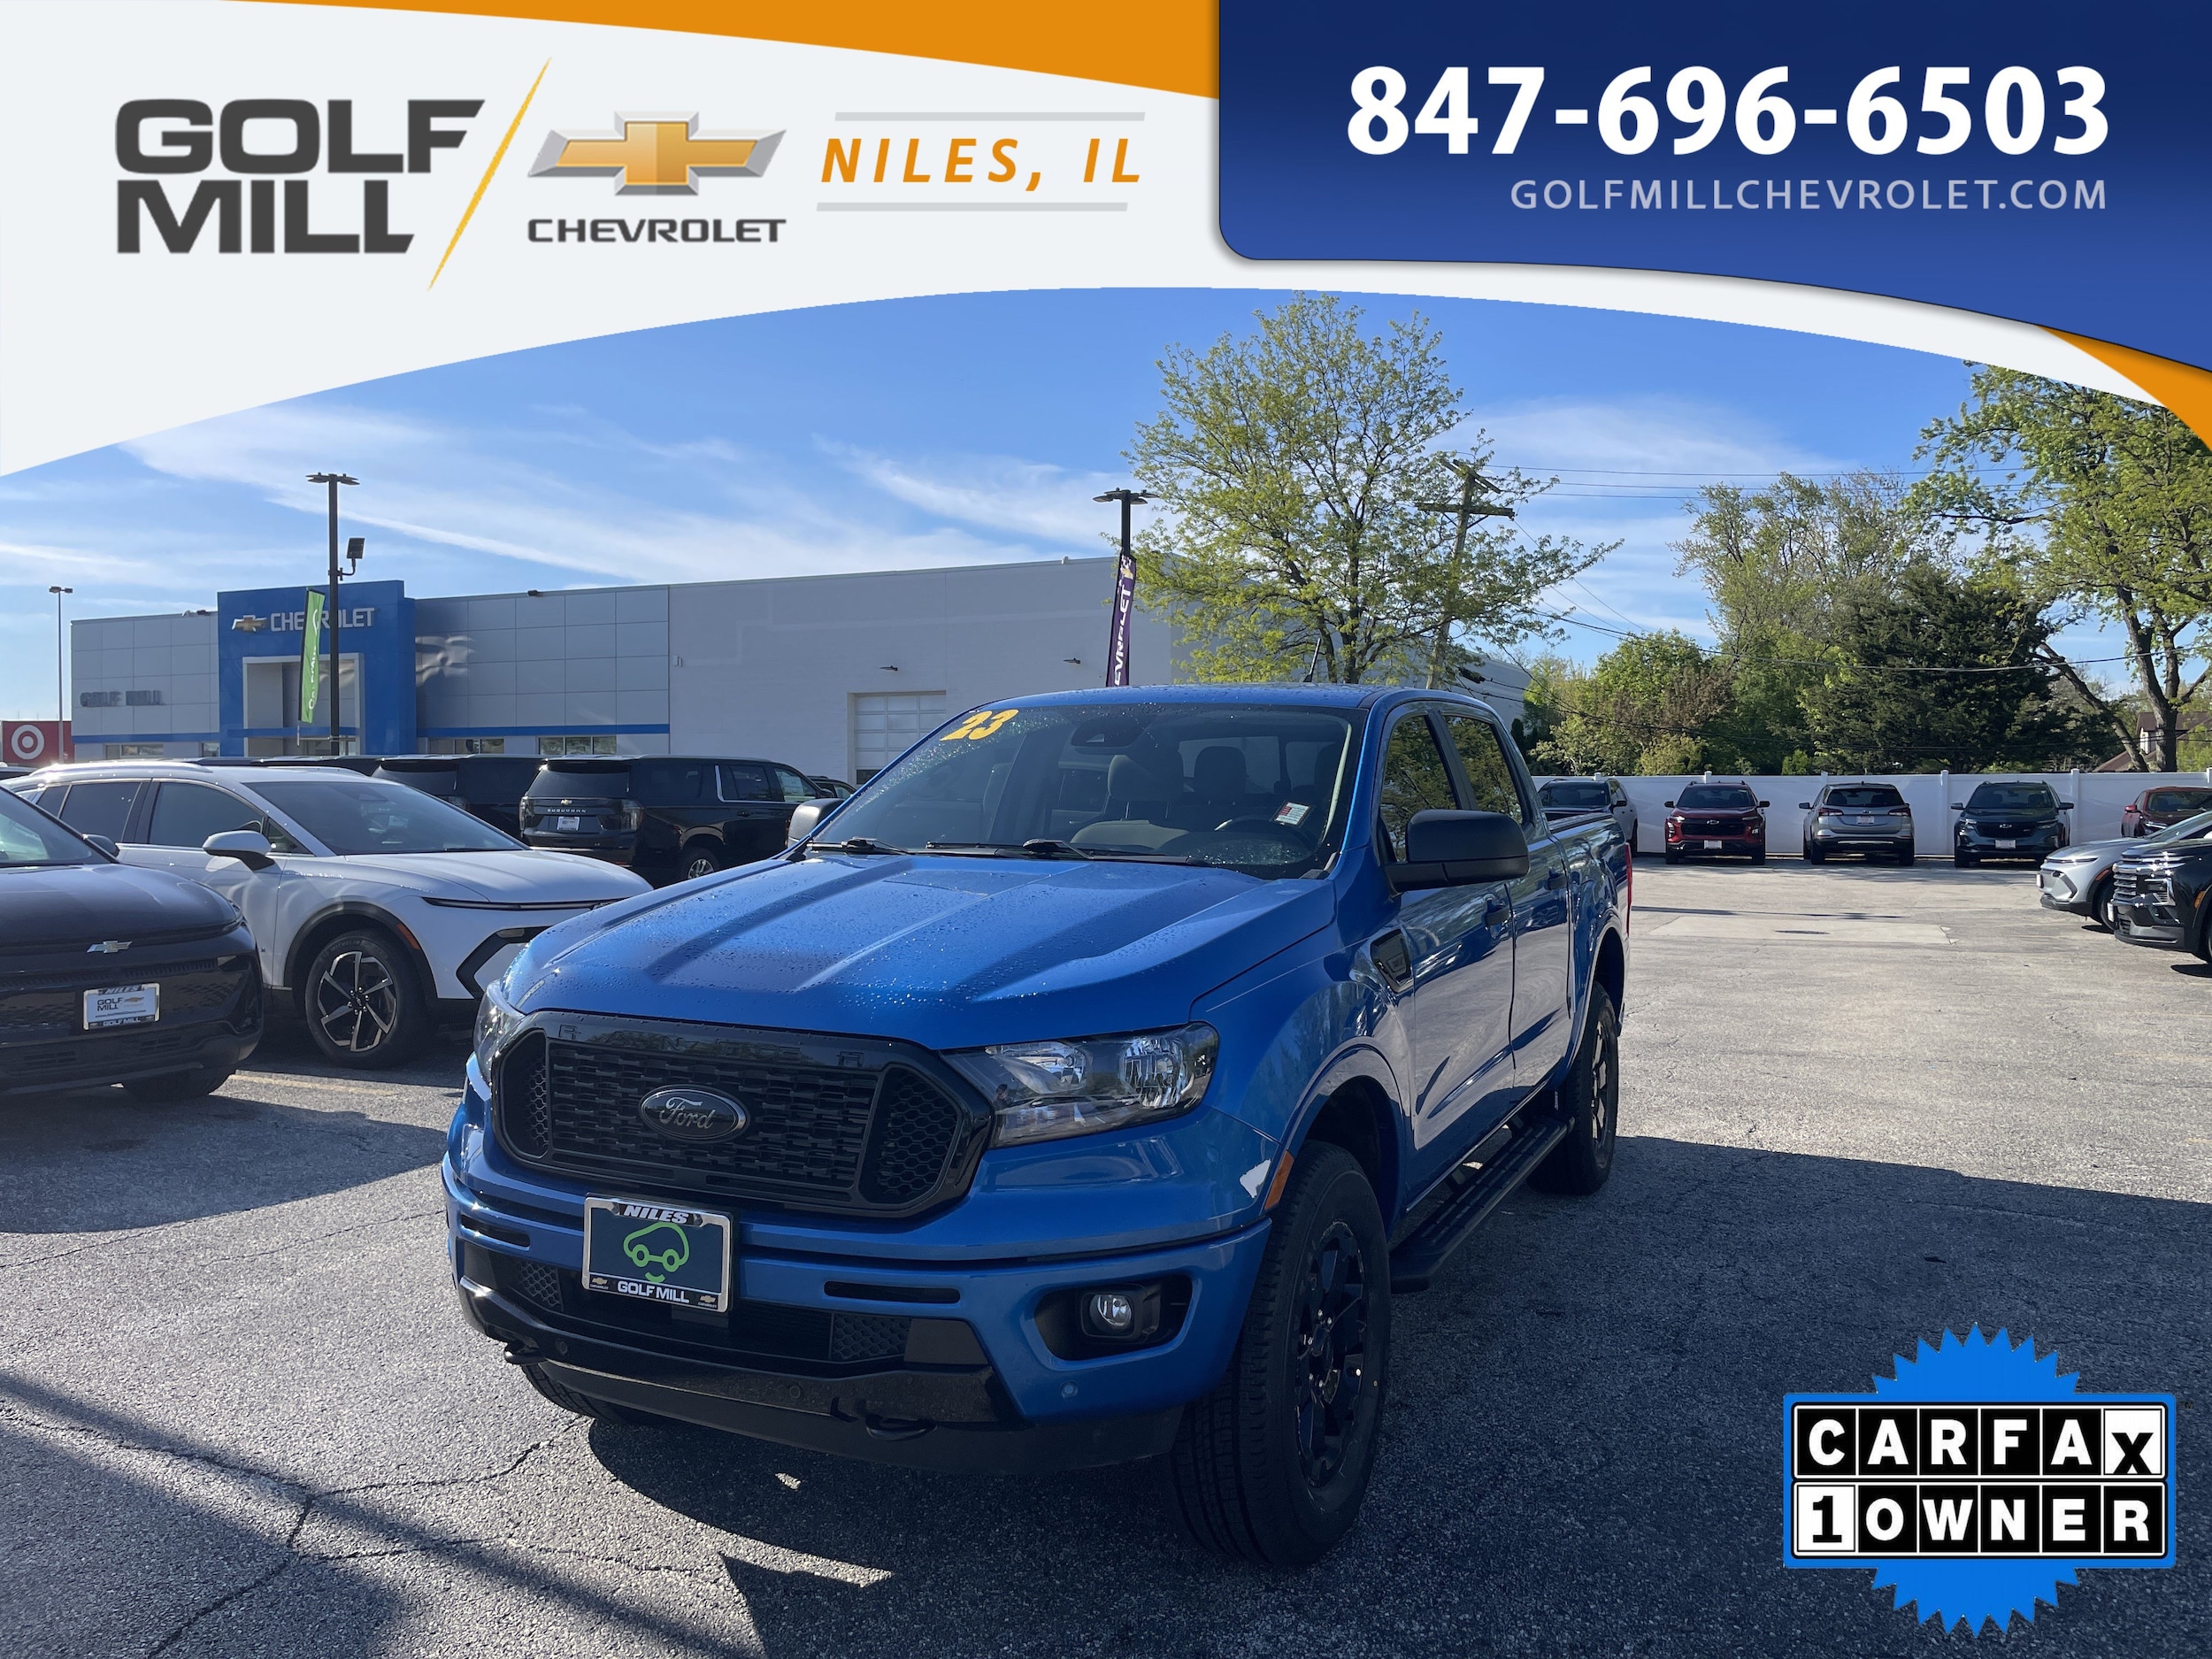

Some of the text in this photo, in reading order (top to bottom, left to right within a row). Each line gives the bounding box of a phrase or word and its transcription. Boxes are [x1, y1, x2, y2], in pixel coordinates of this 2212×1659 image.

[270, 607, 375, 632] CHERLET
[940, 709, 1019, 741] 23
[97, 996, 123, 1006] GOLF
[659, 1096, 716, 1129] Ford
[624, 1205, 689, 1224] NILES
[618, 1280, 690, 1303] GOLF MILL
